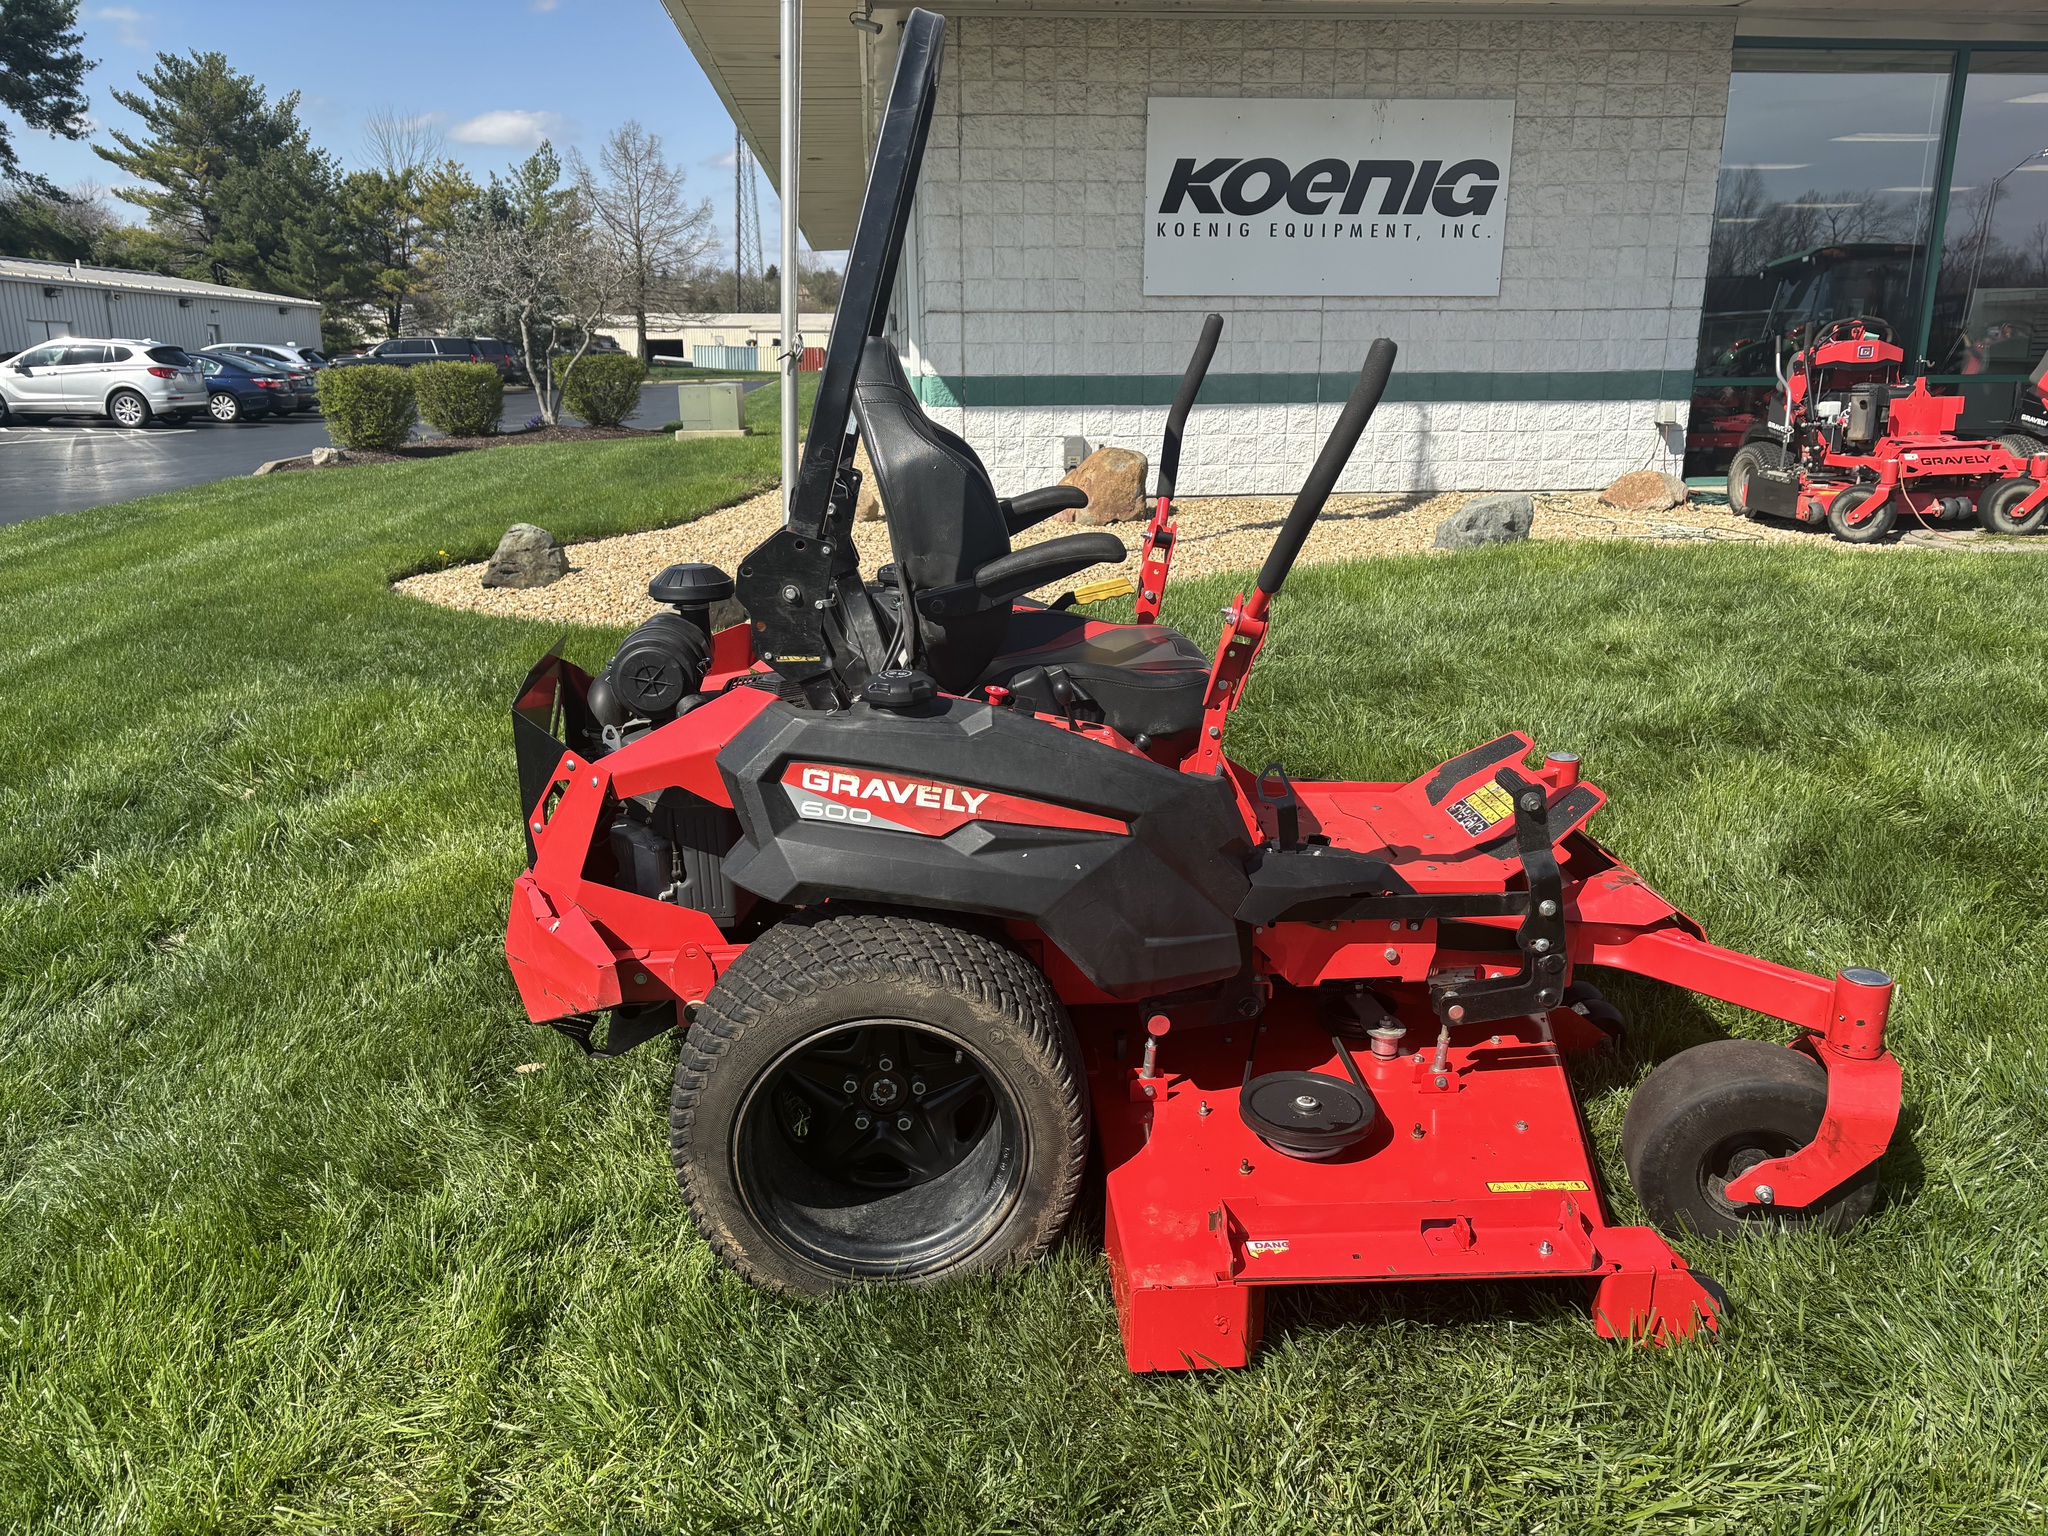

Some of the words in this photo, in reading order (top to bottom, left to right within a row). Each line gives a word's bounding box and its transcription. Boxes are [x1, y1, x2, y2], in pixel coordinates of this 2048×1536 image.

[1156, 222, 1250, 238] KOENIG
[1269, 222, 1421, 241] EQUIPMENT,
[1441, 223, 1492, 239] INC.
[1920, 454, 1992, 466] GRAVELY
[802, 767, 989, 815] GRAVELY
[800, 800, 872, 823] 600
